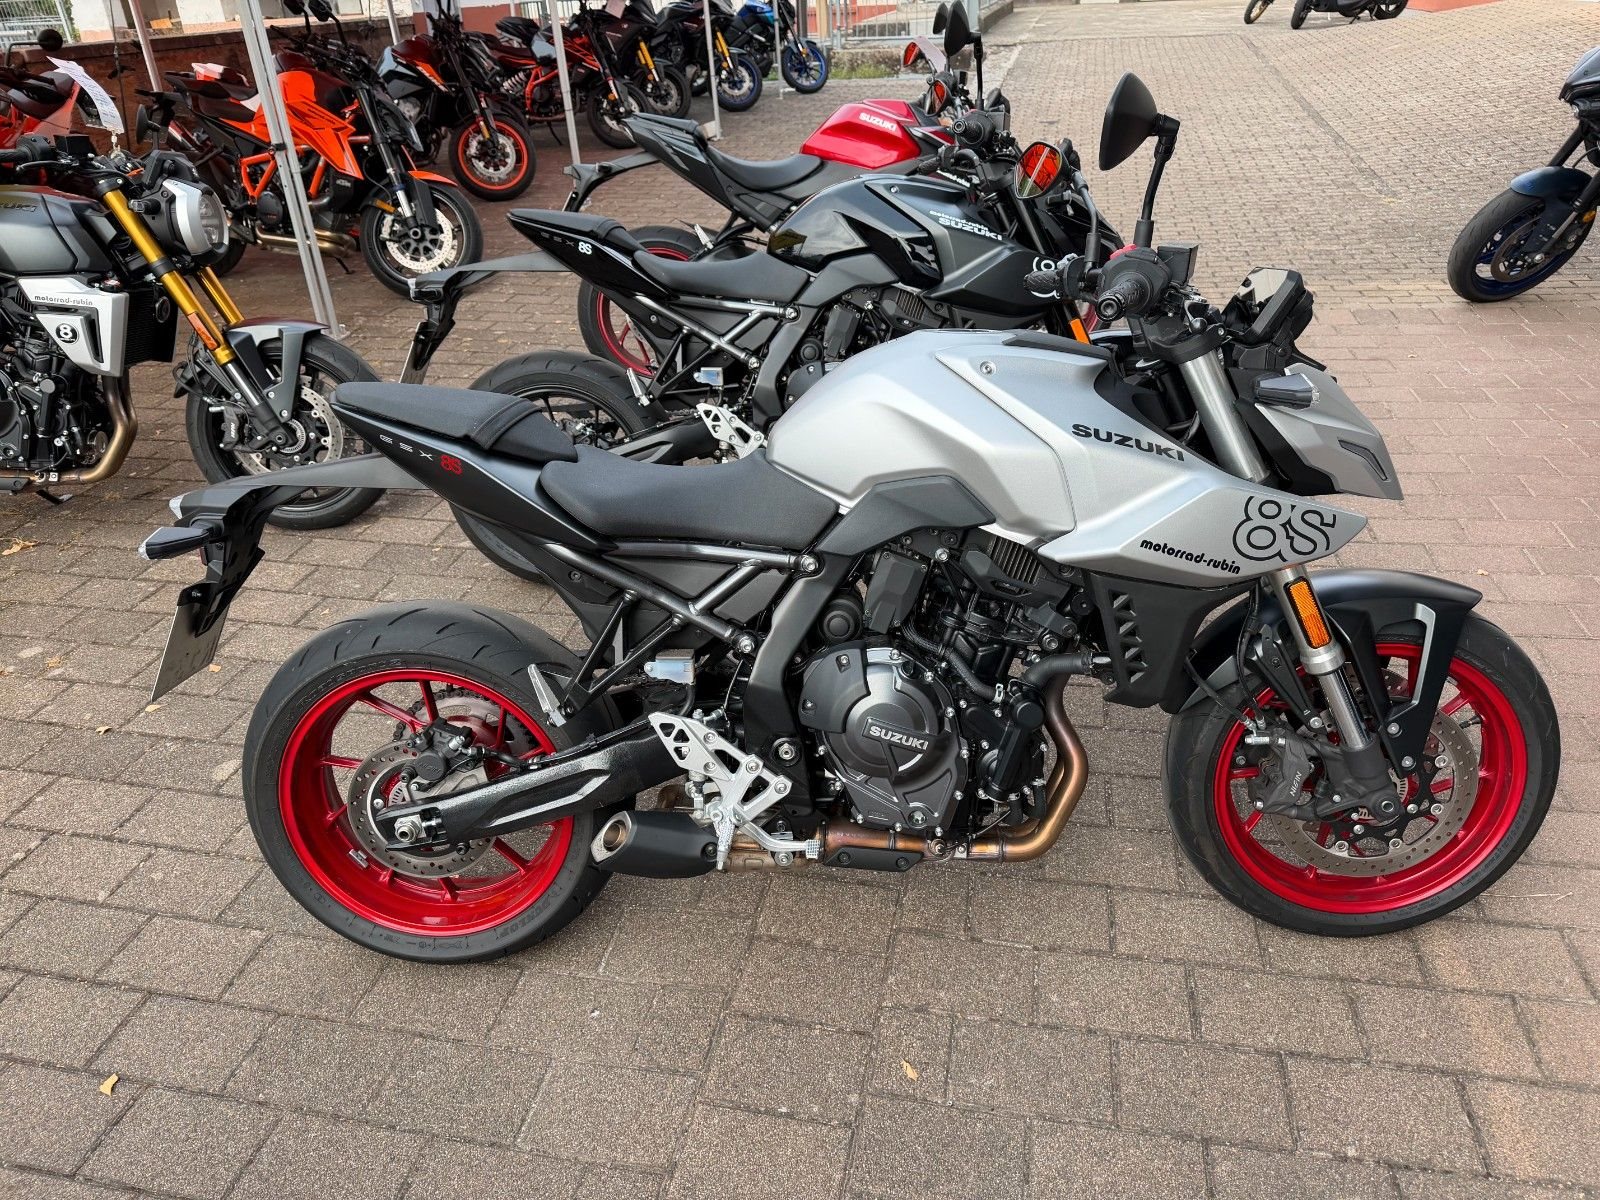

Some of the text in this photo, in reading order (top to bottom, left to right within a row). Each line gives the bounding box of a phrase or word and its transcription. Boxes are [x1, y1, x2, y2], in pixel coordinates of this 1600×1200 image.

[859, 112, 897, 132] SUZUKI
[938, 217, 1003, 241] SUZUKI
[34, 295, 93, 306] motorrad-rubin
[59, 324, 73, 339] 8
[1071, 423, 1185, 462] SUZUKI
[1232, 495, 1337, 563] 8S
[1139, 538, 1241, 575] motorrad-rubin
[869, 725, 929, 750] SUZUKI
